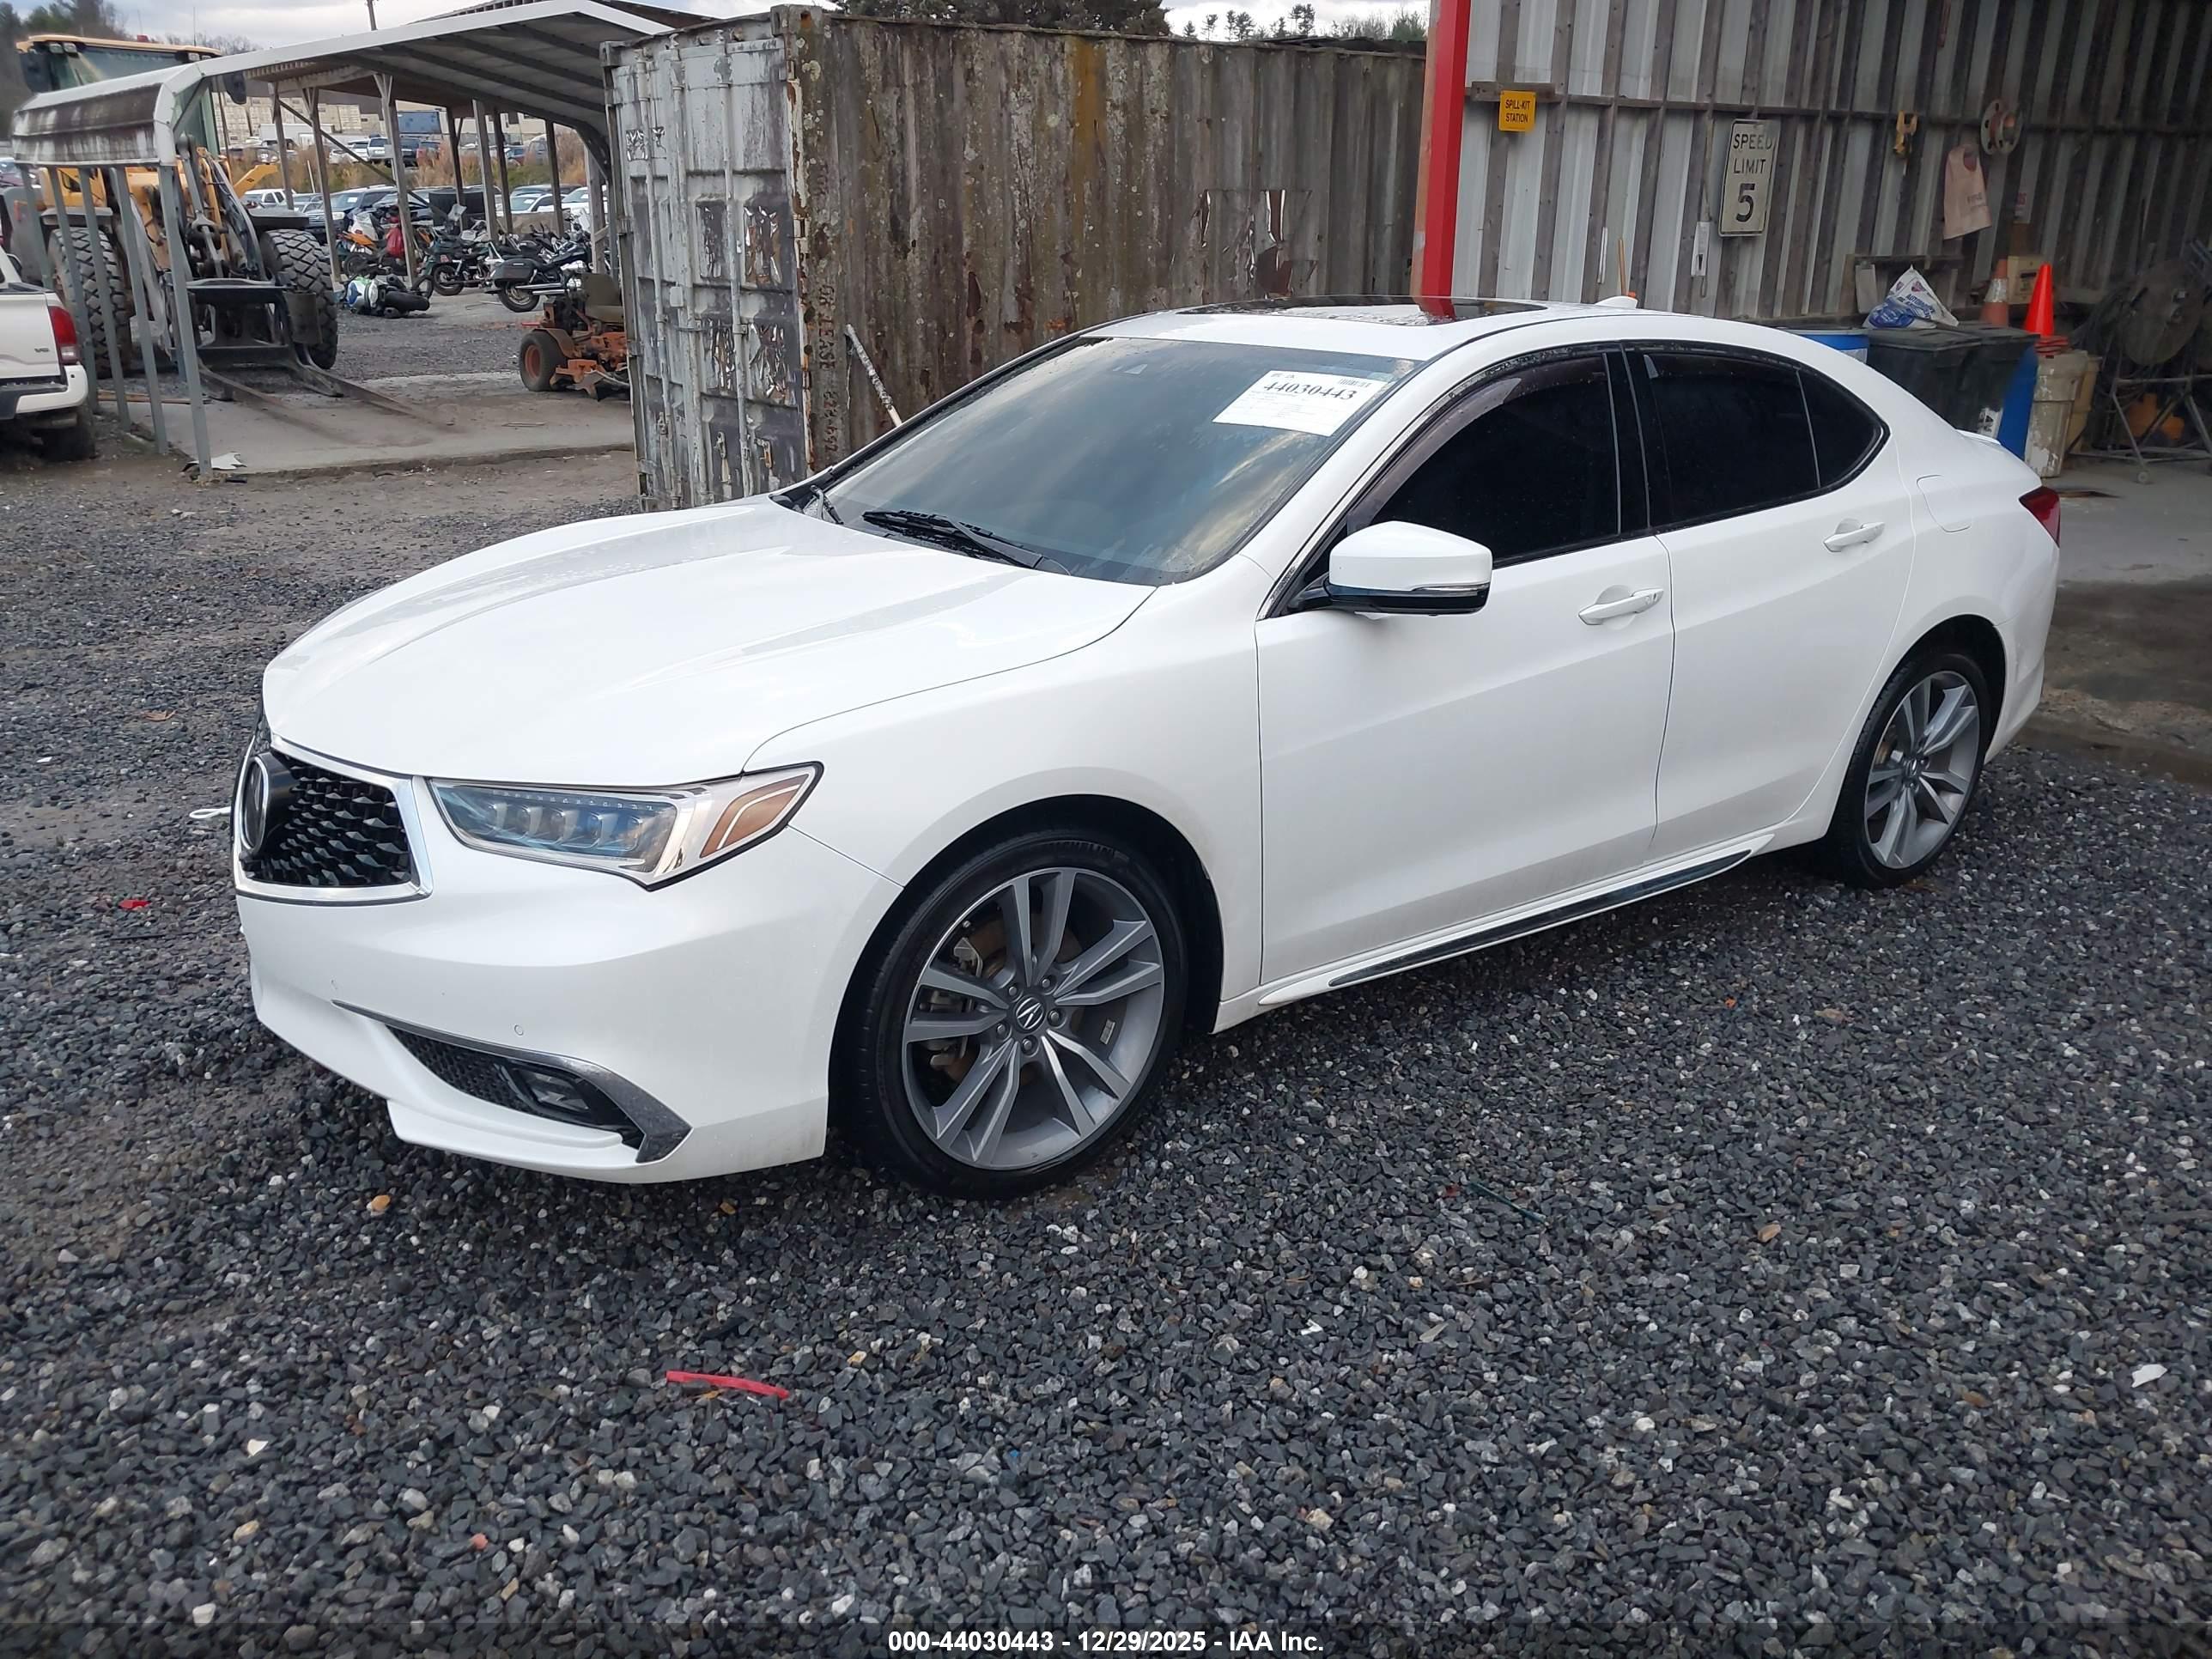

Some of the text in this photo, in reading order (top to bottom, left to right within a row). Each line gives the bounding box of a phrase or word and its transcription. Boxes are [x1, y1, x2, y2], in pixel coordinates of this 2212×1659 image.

[1504, 99, 1531, 110] SPILL-KIT
[1505, 112, 1528, 124] STATION
[1733, 133, 1772, 150] SPEED
[1733, 158, 1766, 174] LIMIT
[1735, 182, 1756, 222] 5
[818, 313, 836, 369] LEASE
[1263, 381, 1358, 401] 44030443
